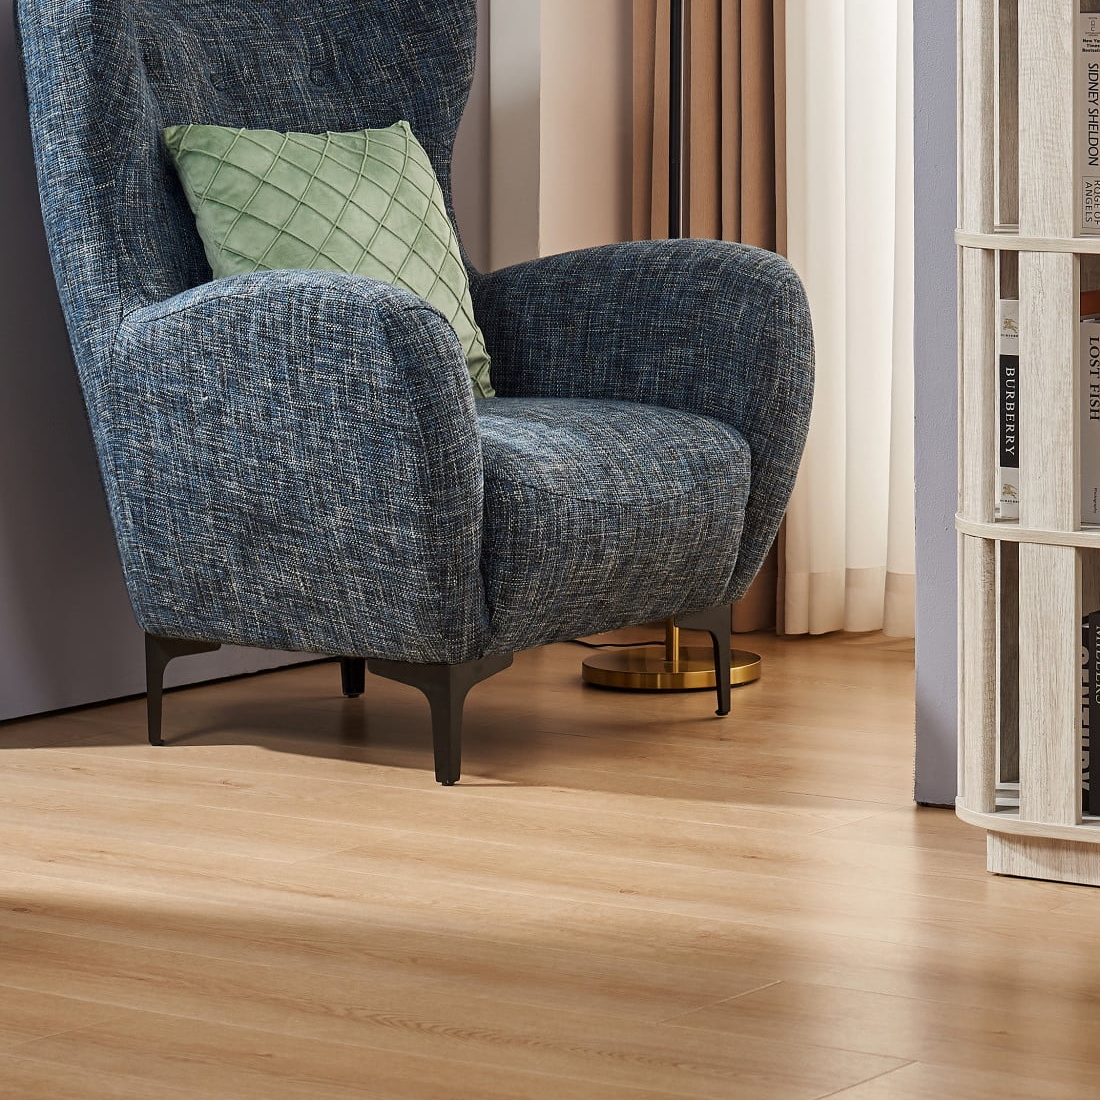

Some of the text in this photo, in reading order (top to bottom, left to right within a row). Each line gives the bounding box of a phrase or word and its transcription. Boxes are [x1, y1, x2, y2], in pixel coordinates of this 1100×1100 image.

[1087, 62, 1099, 166] SIDNEY SHELDON
[1085, 181, 1093, 223] ANGELS
[1005, 366, 1016, 456] BURBERRY
[1089, 336, 1100, 421] LOST FISH
